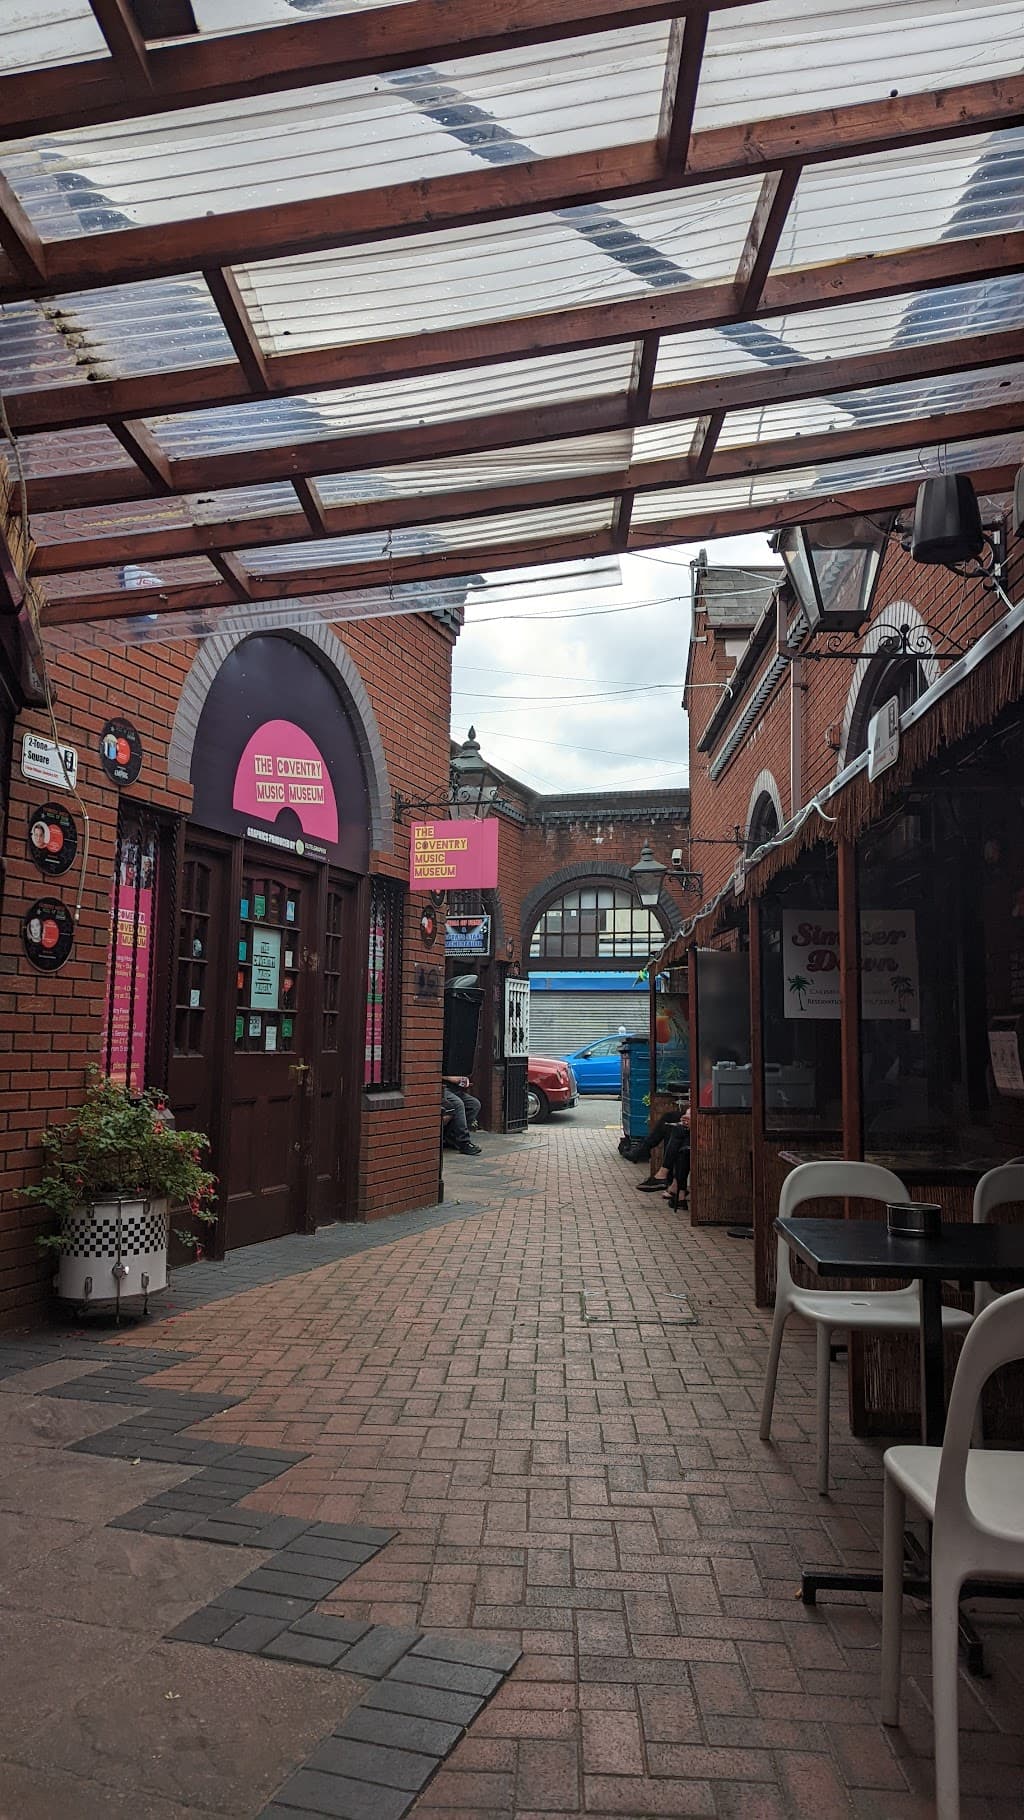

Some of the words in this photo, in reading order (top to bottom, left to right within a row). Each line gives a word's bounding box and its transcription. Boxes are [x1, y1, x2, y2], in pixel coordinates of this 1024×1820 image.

[28, 737, 48, 751] 2-Tone
[27, 750, 50, 765] Square
[255, 757, 273, 774] THE
[278, 759, 321, 778] COVENTRY
[256, 783, 285, 800] MUSIC
[289, 785, 324, 802] MUSEUM
[416, 827, 434, 837] THE
[415, 839, 467, 850] COVENTRY
[415, 853, 445, 863] MUSIC
[414, 866, 456, 877] MUSEUM
